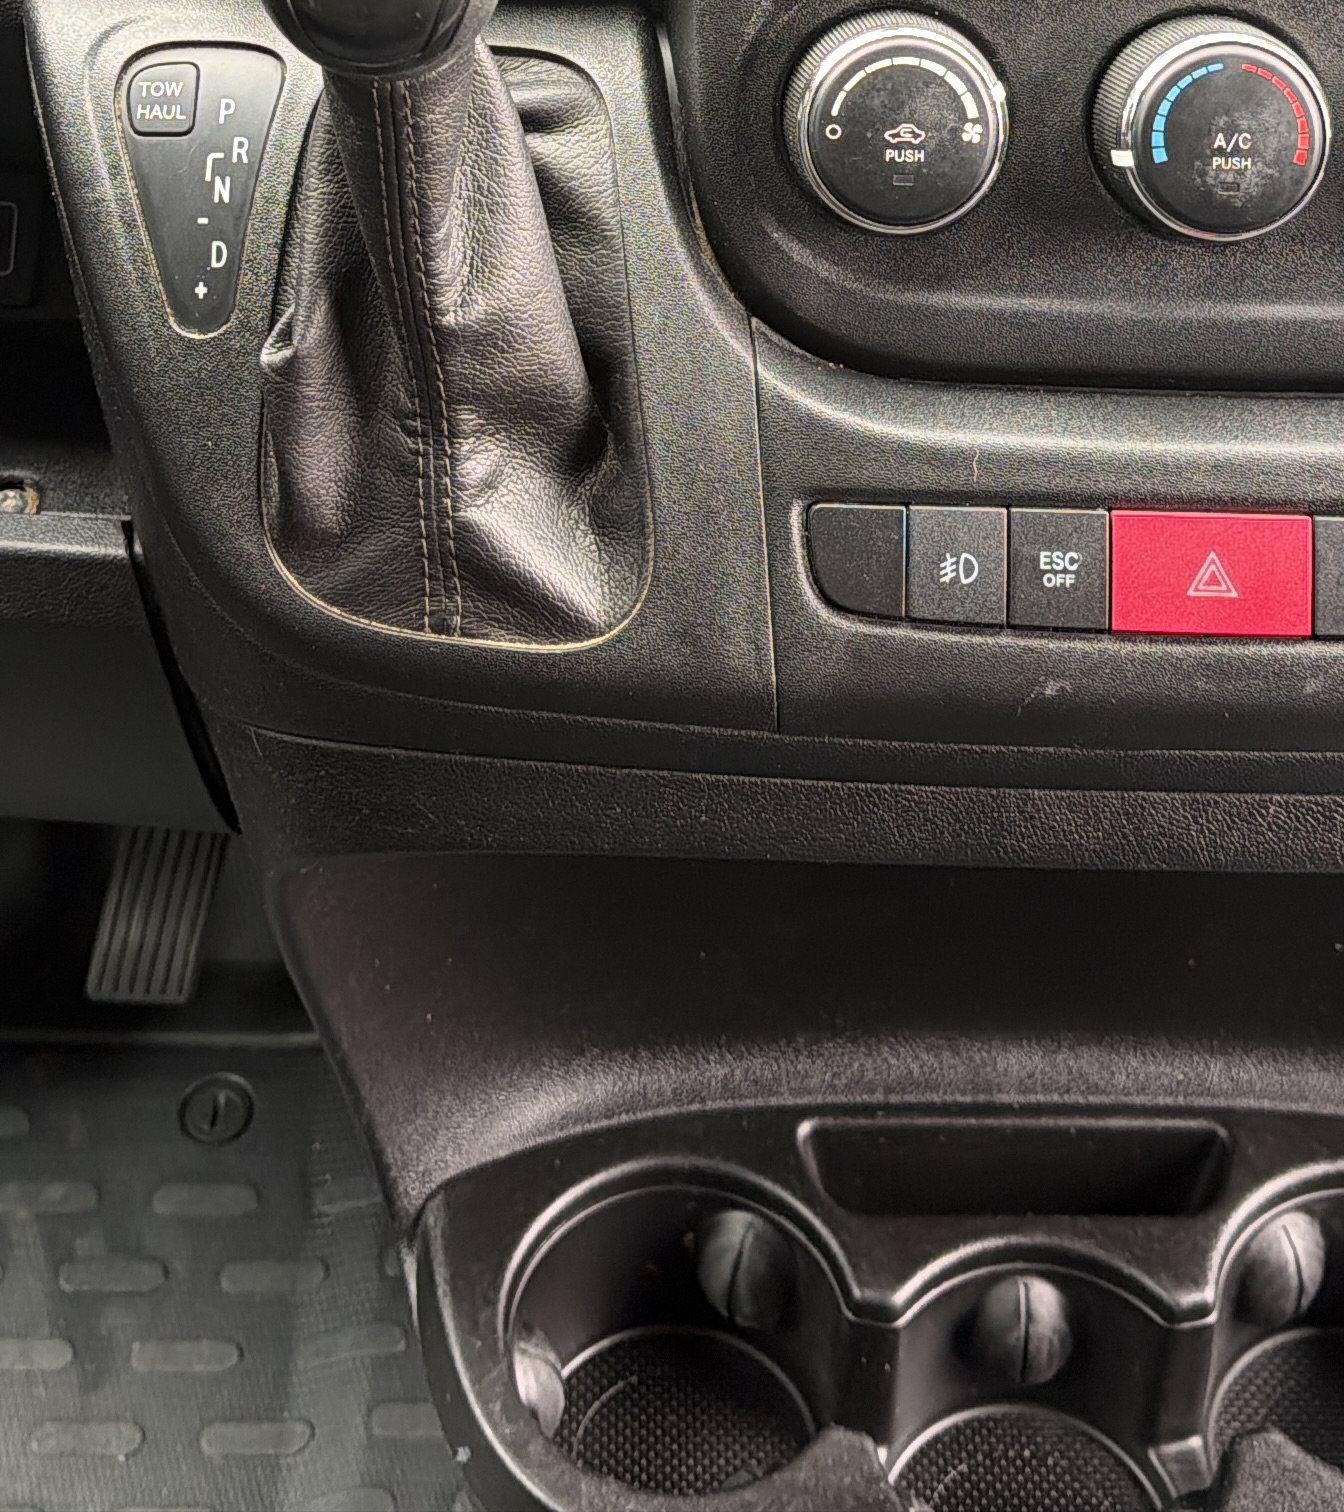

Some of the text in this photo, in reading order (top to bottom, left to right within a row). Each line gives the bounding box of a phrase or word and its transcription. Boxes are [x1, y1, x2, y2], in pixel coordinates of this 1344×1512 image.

[138, 81, 184, 98] TOW
[136, 104, 187, 121] HAUL
[219, 98, 236, 124] P
[232, 136, 249, 164] R
[1212, 132, 1253, 151] A/C
[884, 148, 925, 164] PUSH
[1211, 155, 1253, 171] PUSH
[213, 175, 230, 204] N
[211, 240, 228, 269] D
[1038, 550, 1080, 572] ESC
[1042, 571, 1076, 589] OFF
